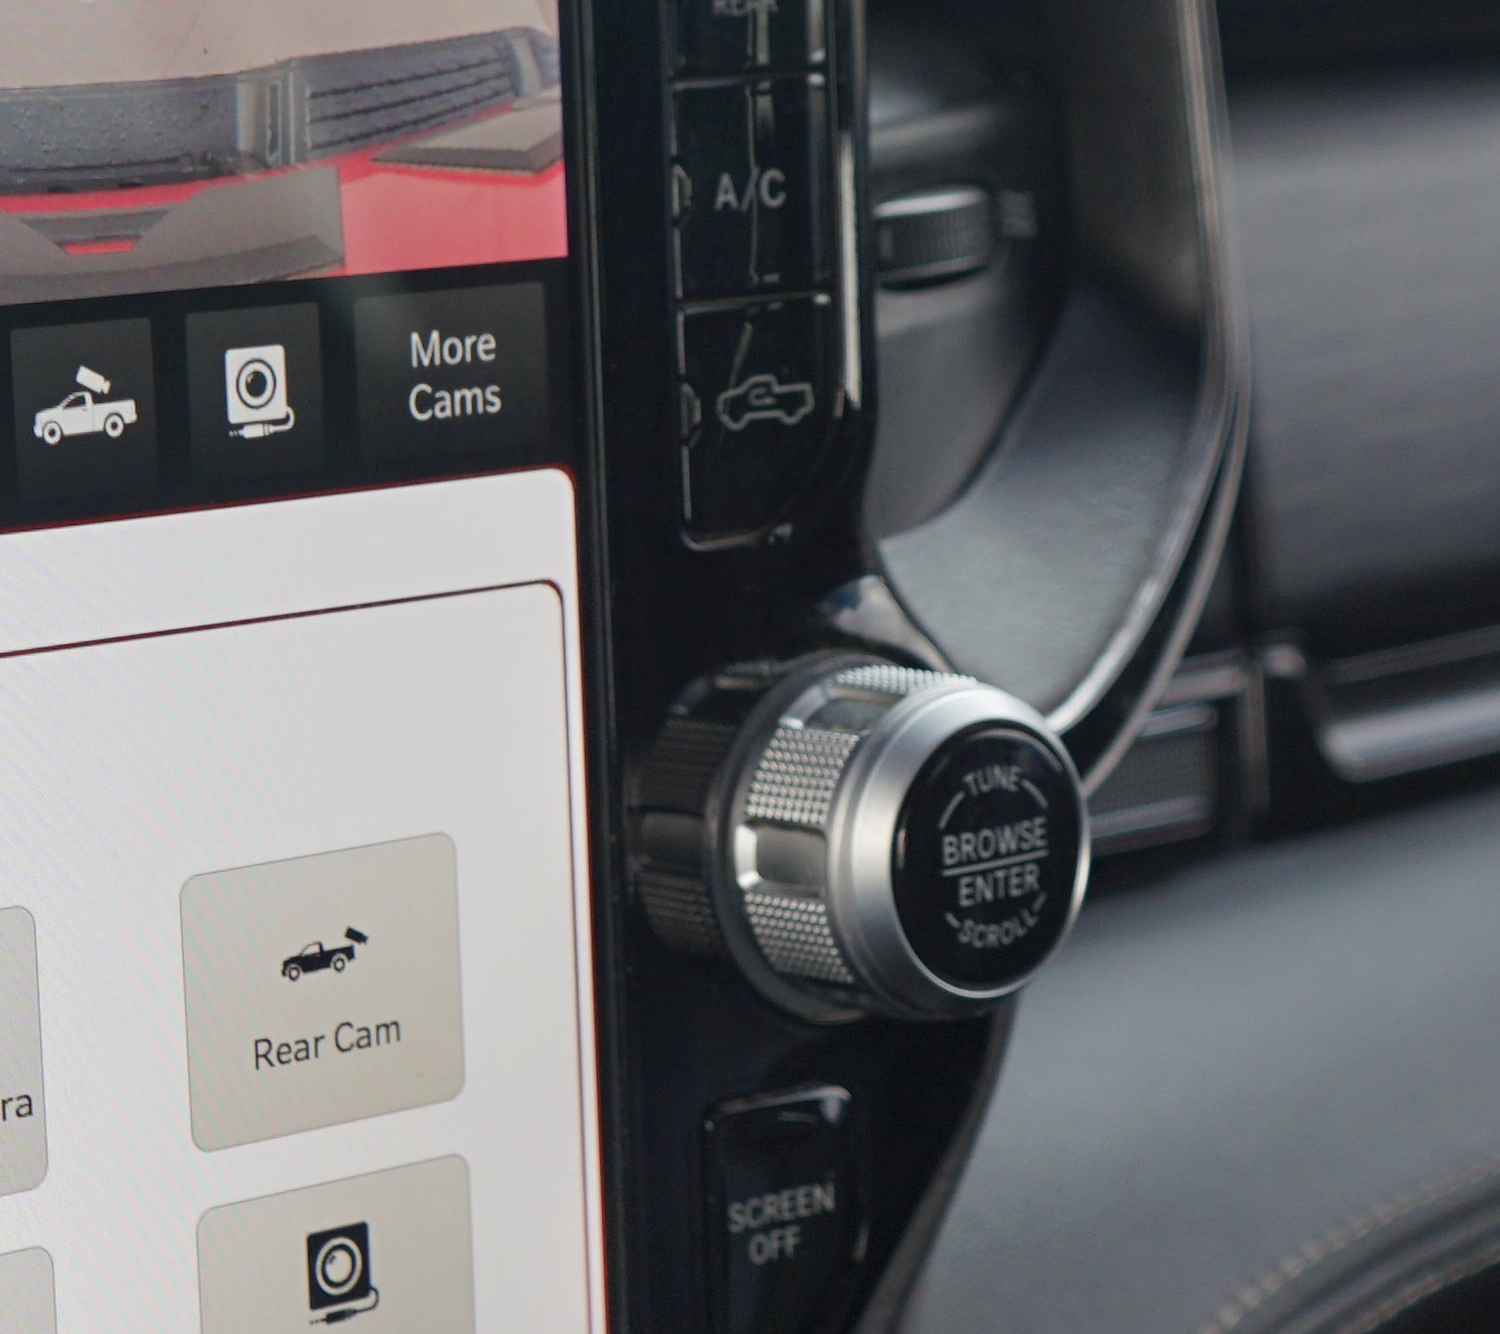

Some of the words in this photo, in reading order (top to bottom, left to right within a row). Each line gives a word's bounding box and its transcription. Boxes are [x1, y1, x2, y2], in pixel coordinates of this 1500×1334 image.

[714, 169, 788, 213] A/C
[410, 329, 497, 369] More
[408, 382, 502, 421] Cams
[963, 764, 1022, 796] TUNE
[942, 816, 1048, 866] BROWSE
[958, 862, 1040, 908] ENTER
[957, 909, 1039, 948] SCROLL
[253, 1030, 326, 1070] Rear
[333, 1017, 402, 1055] Cam
[728, 1183, 834, 1230] SCREEN
[749, 1227, 800, 1264] OFF
